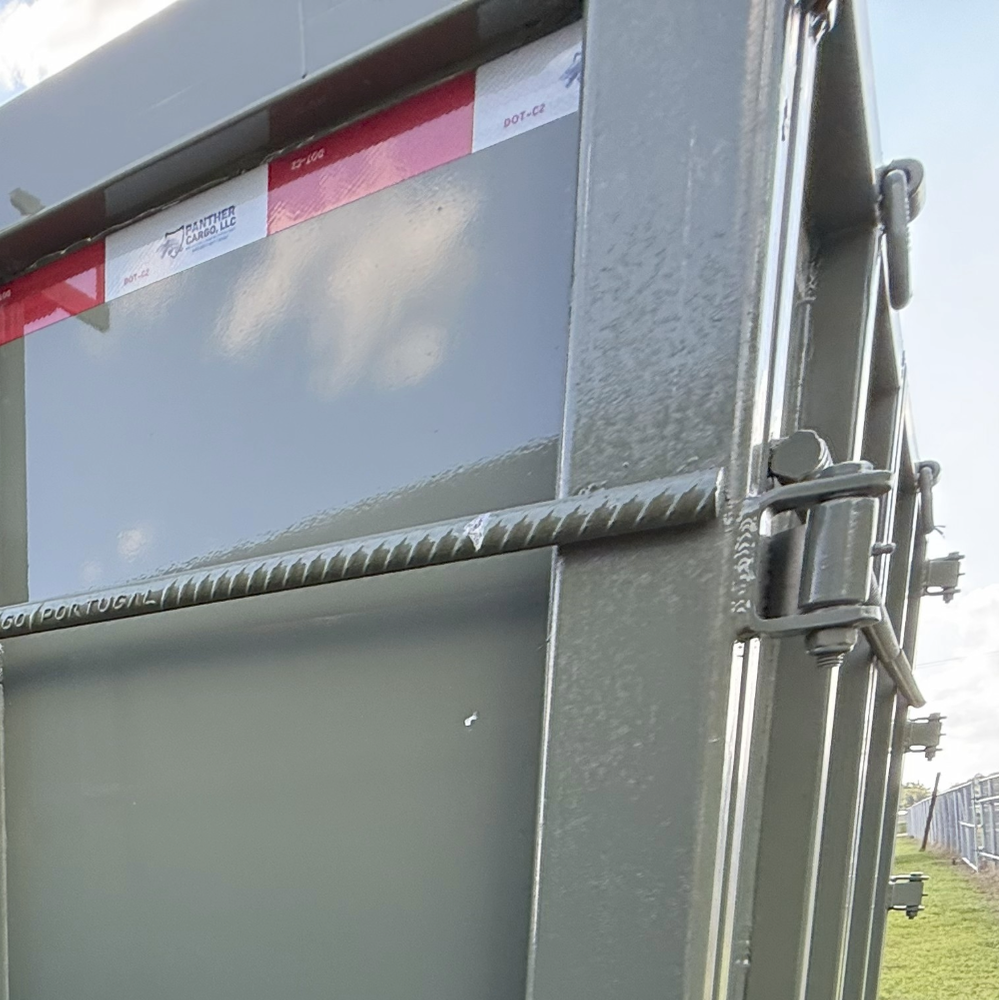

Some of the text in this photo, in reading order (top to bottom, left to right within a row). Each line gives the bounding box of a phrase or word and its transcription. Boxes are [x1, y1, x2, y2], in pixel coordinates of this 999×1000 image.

[503, 103, 546, 128] DOT-C2
[185, 204, 236, 236] PANTHER
[186, 225, 219, 245] CARGO,
[220, 216, 236, 231] LLC
[41, 589, 157, 624] PORTUGAL
